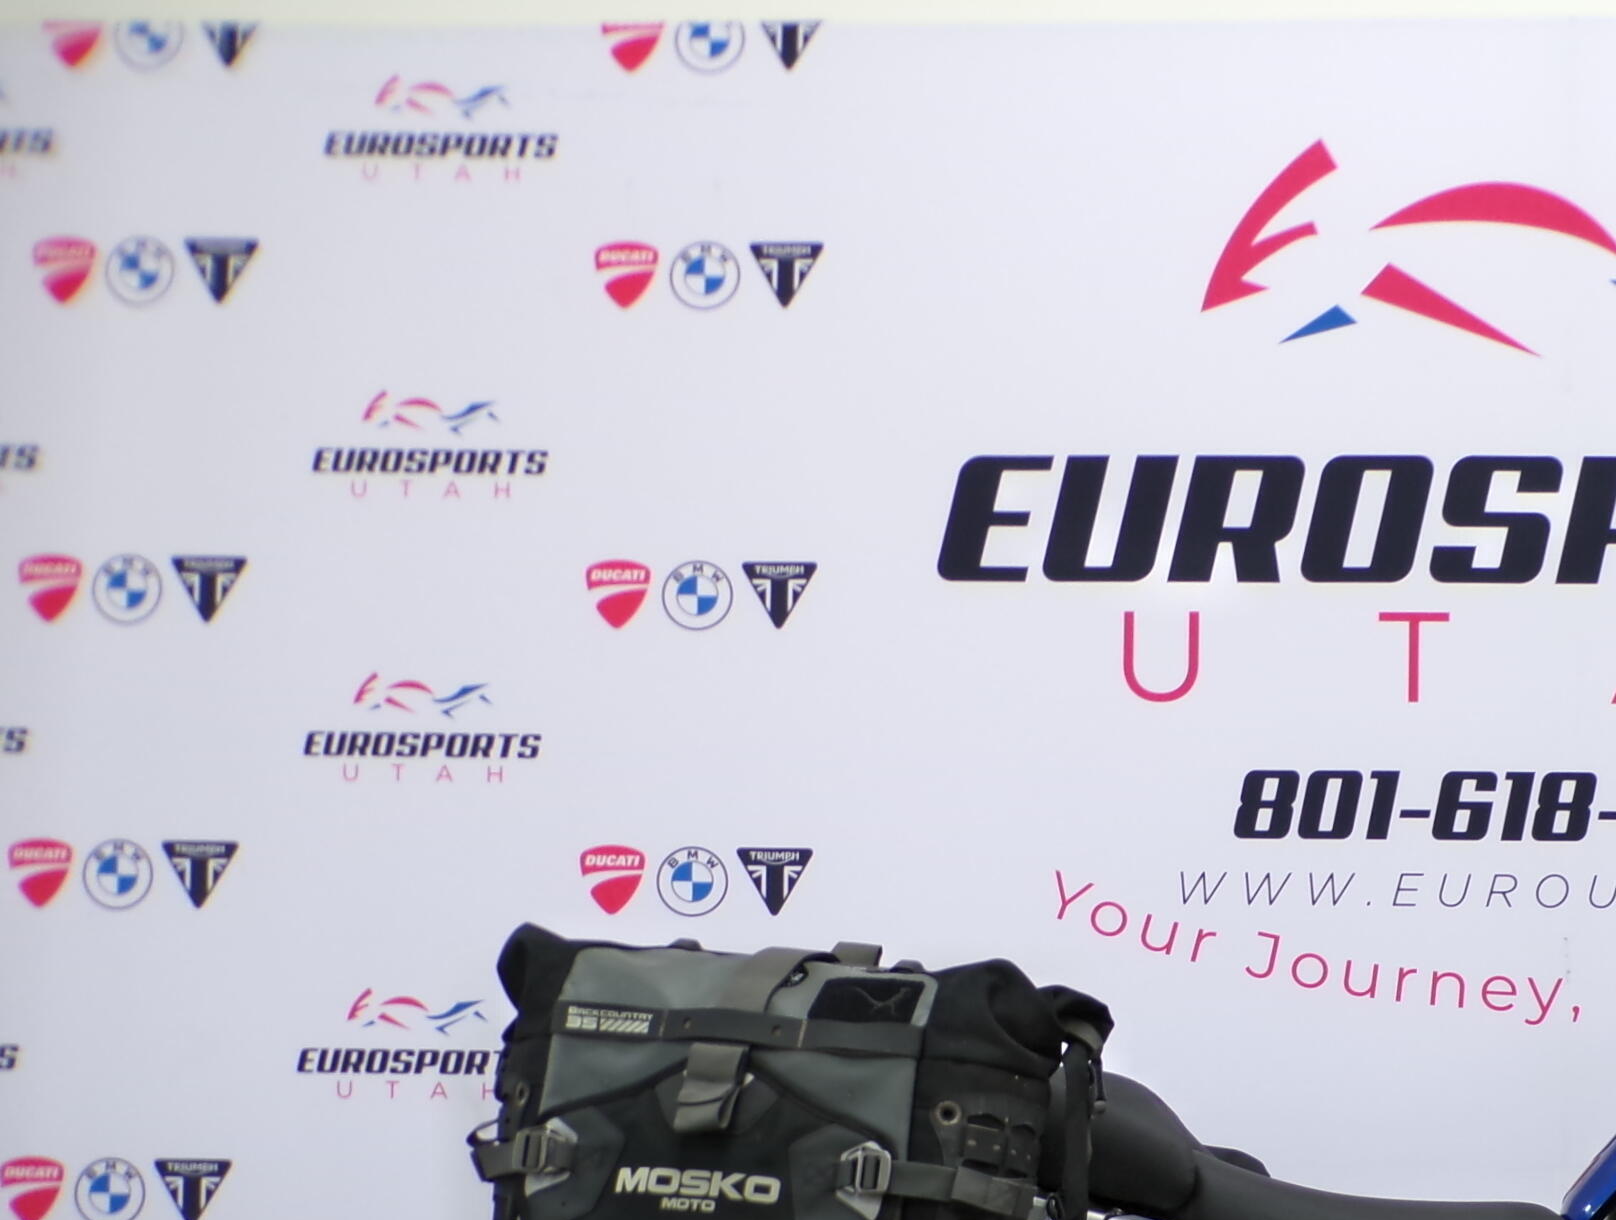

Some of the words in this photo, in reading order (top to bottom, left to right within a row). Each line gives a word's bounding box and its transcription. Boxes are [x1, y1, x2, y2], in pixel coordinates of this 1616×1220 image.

[324, 132, 558, 159] EUROSPORTS
[312, 448, 548, 476] EUROSPORTS
[350, 481, 512, 499] UTAH
[590, 567, 646, 582] DUCATI
[672, 563, 724, 583] BMW
[754, 564, 805, 576] TRIUMPH
[303, 731, 542, 760] EUROSPORTS
[342, 765, 504, 783] UTAH
[92, 841, 143, 861] BMW
[584, 853, 641, 867] DUCATI
[667, 849, 719, 869] BMW
[749, 850, 800, 862] TRIUMPH
[1054, 870, 1217, 964] Your
[1245, 931, 1582, 1027] Journey,
[297, 1047, 501, 1075] EUROSPOR
[4, 1163, 60, 1181] DUCATI
[85, 1160, 137, 1180] BMW
[615, 1166, 782, 1204] MOSKO
[660, 1197, 716, 1213] MOTO
